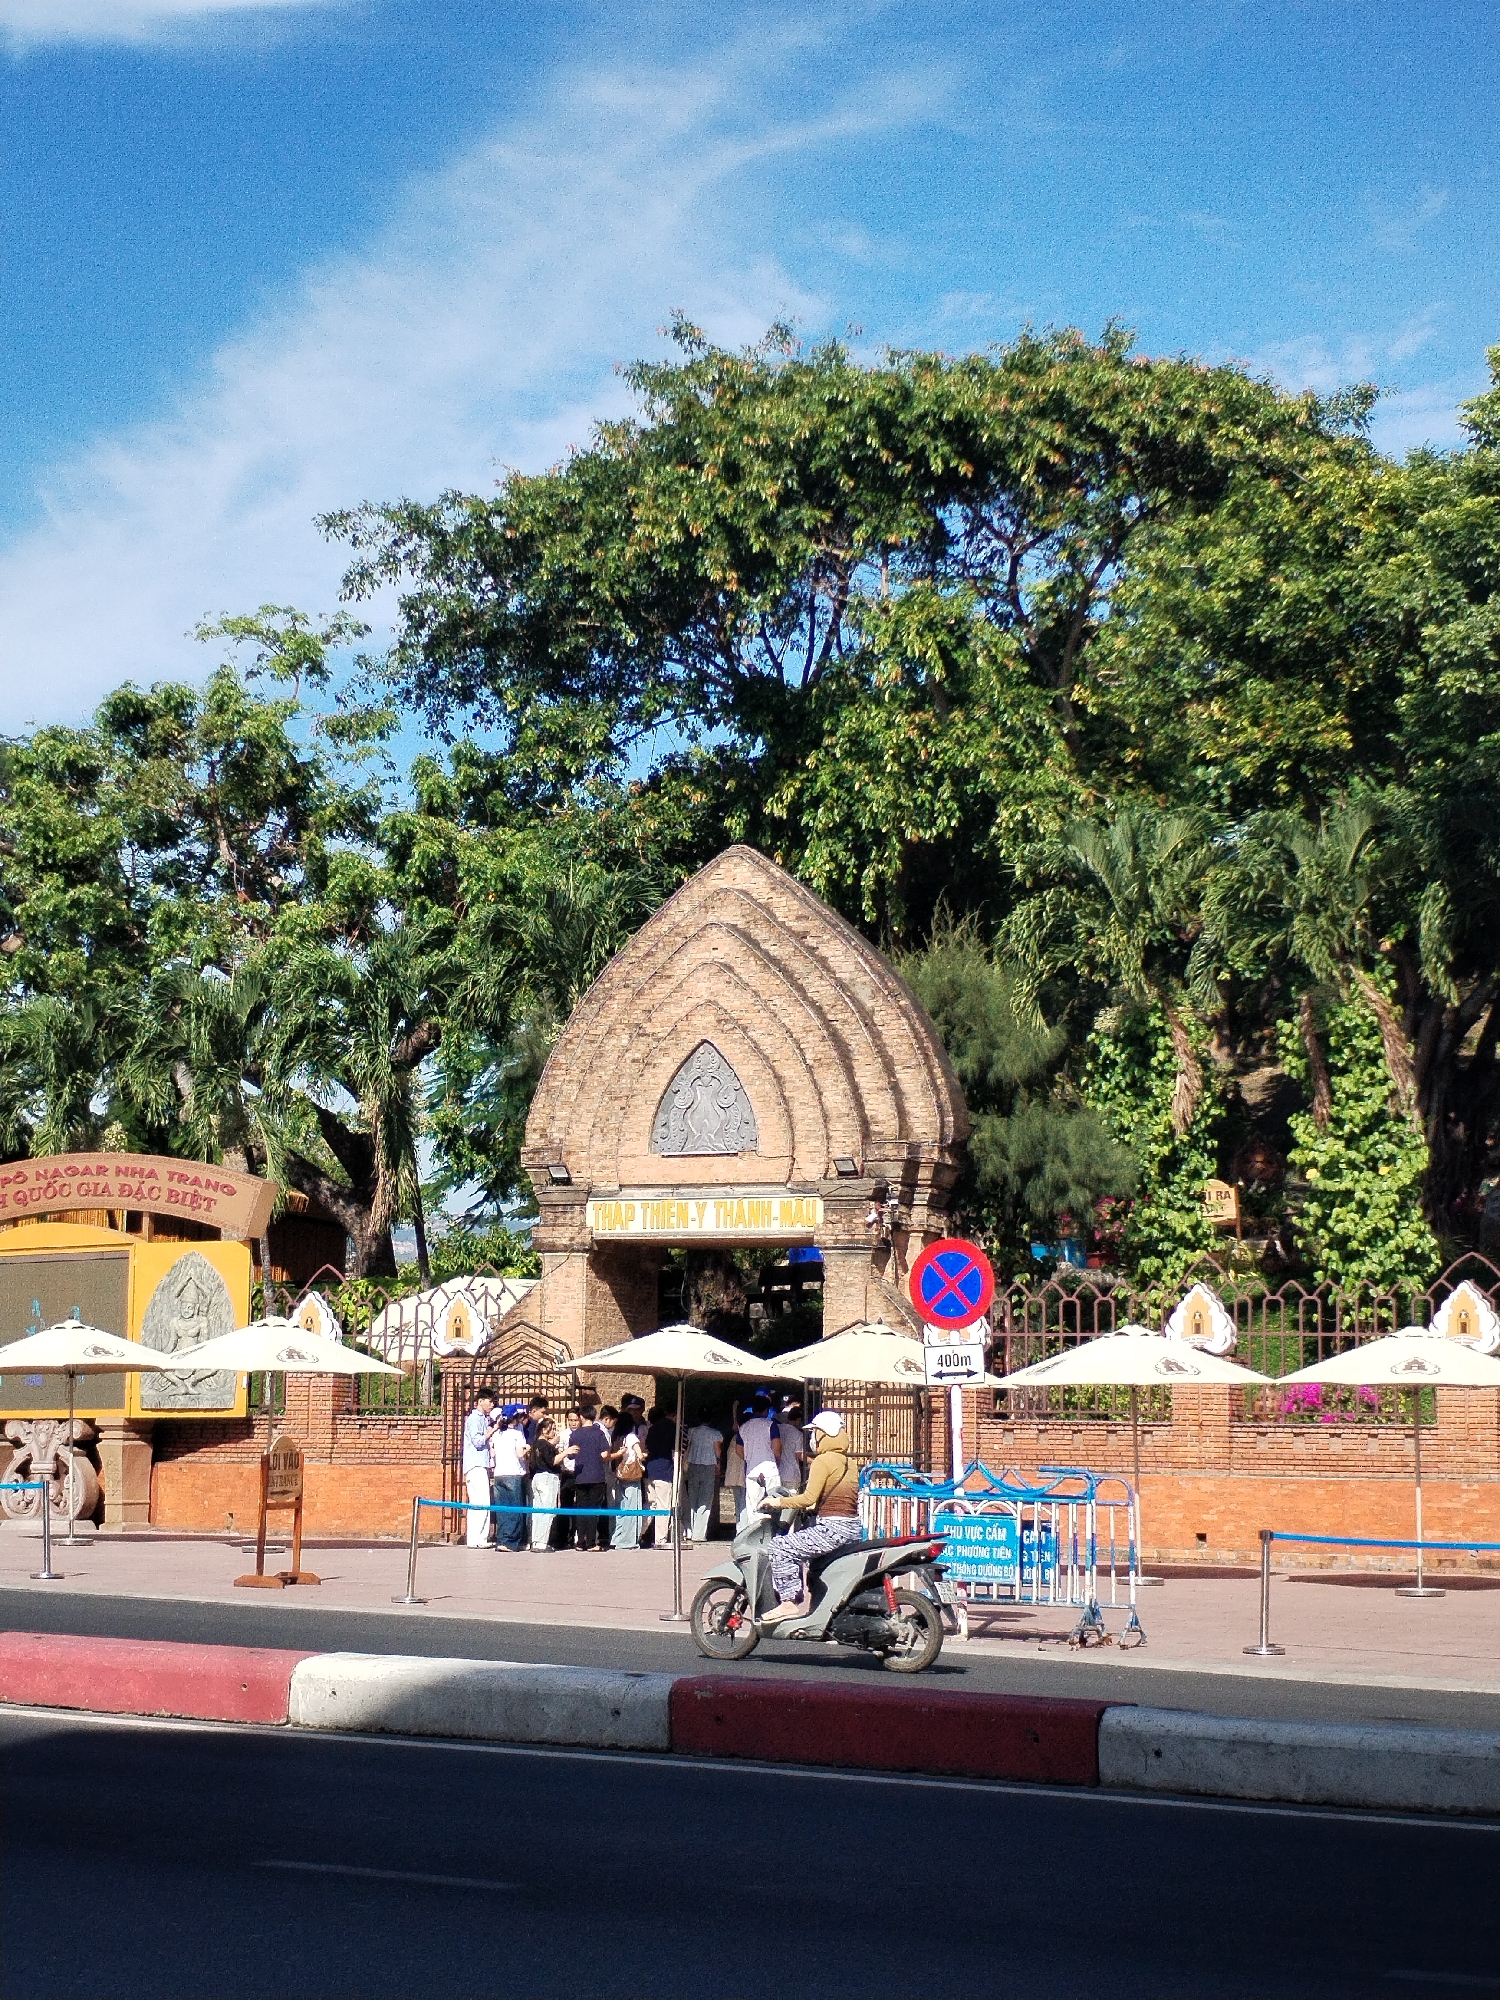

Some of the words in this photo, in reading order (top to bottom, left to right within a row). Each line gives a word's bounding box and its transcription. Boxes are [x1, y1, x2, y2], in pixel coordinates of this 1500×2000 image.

[35, 1164, 109, 1181] NAGAR
[115, 1165, 159, 1180] NHA
[166, 1170, 237, 1196] TRANG
[13, 1179, 72, 1207] QUỐC
[77, 1182, 114, 1197] GIA
[118, 1180, 161, 1201] ĐẶC
[166, 1187, 217, 1212] BIỆT
[1216, 1190, 1231, 1200] RA
[593, 1200, 635, 1230] THÁP
[937, 1353, 972, 1367] 400m
[943, 1524, 963, 1540] KHU
[964, 1525, 984, 1542] VỰC
[985, 1522, 1007, 1541] CẤM
